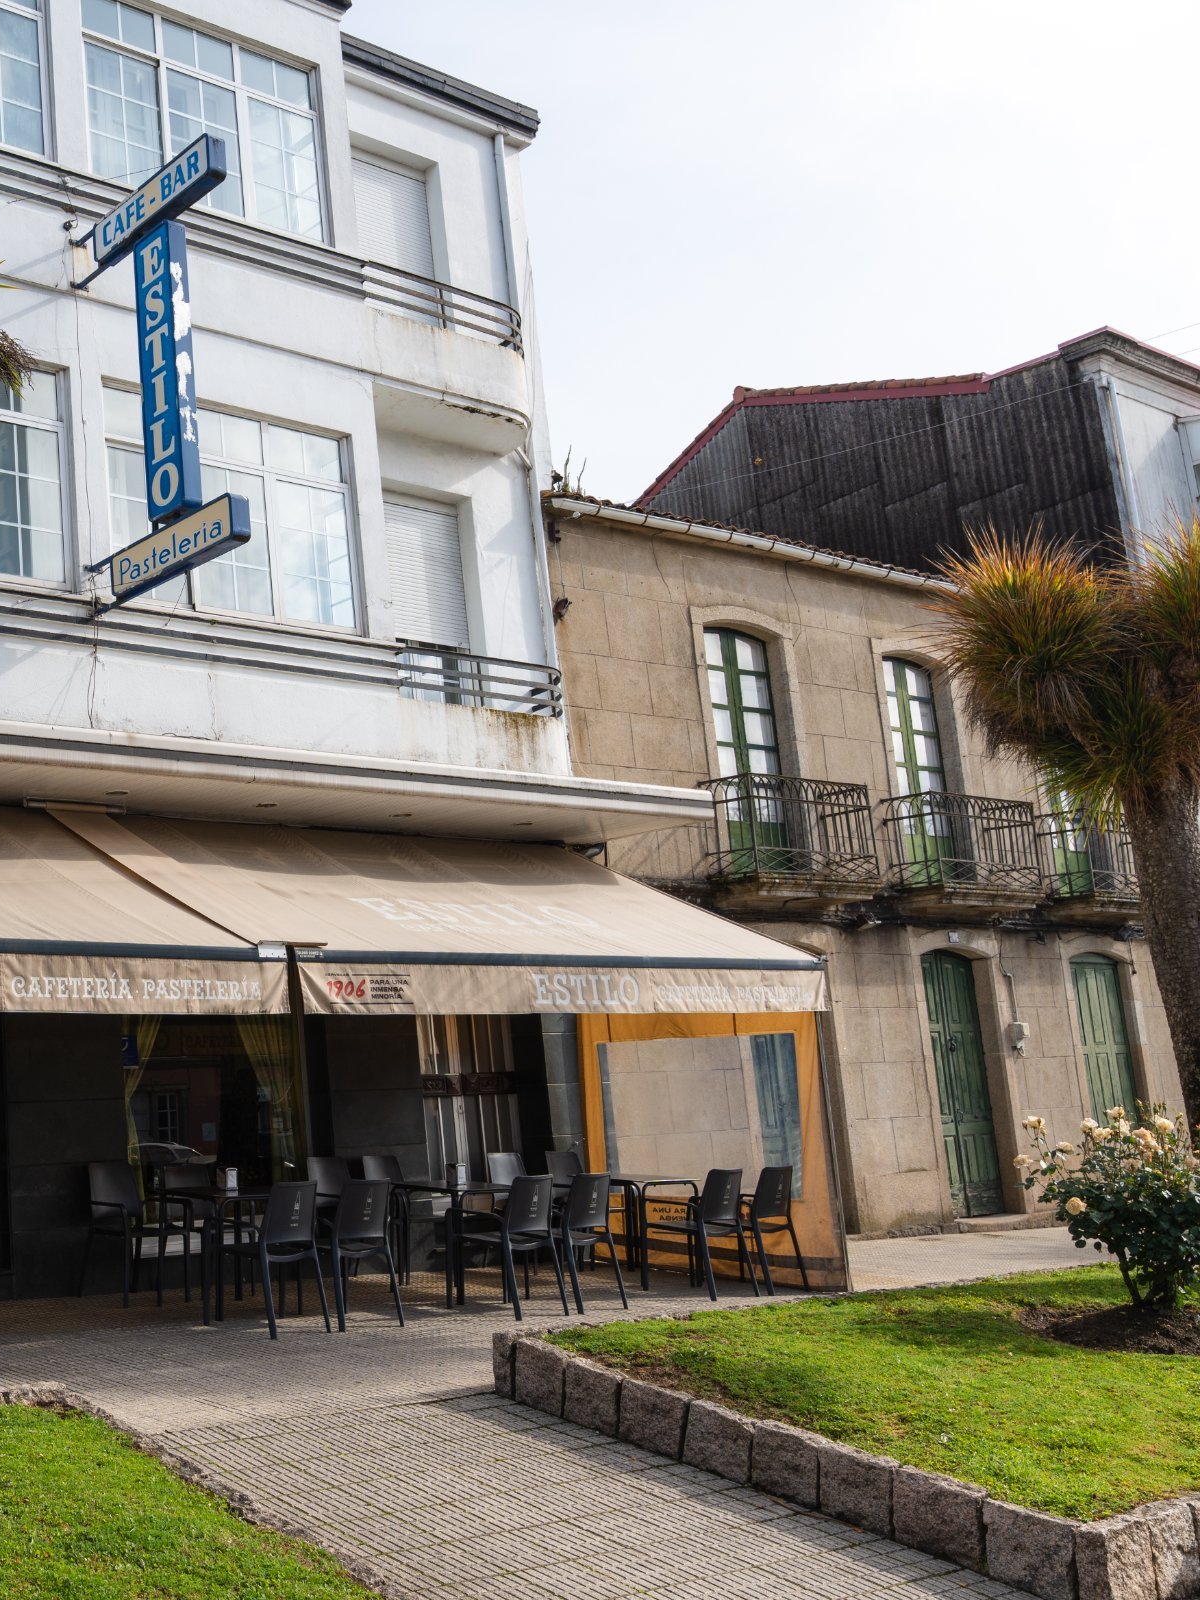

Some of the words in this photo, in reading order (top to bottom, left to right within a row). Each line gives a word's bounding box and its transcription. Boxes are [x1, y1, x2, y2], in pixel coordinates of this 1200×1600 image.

[140, 236, 180, 507] ESTILO
[11, 971, 134, 1000] CAFETERÍA
[142, 976, 262, 1001] PASTELERÍA
[327, 978, 366, 998] 1906
[534, 973, 641, 1006] ESTILO
